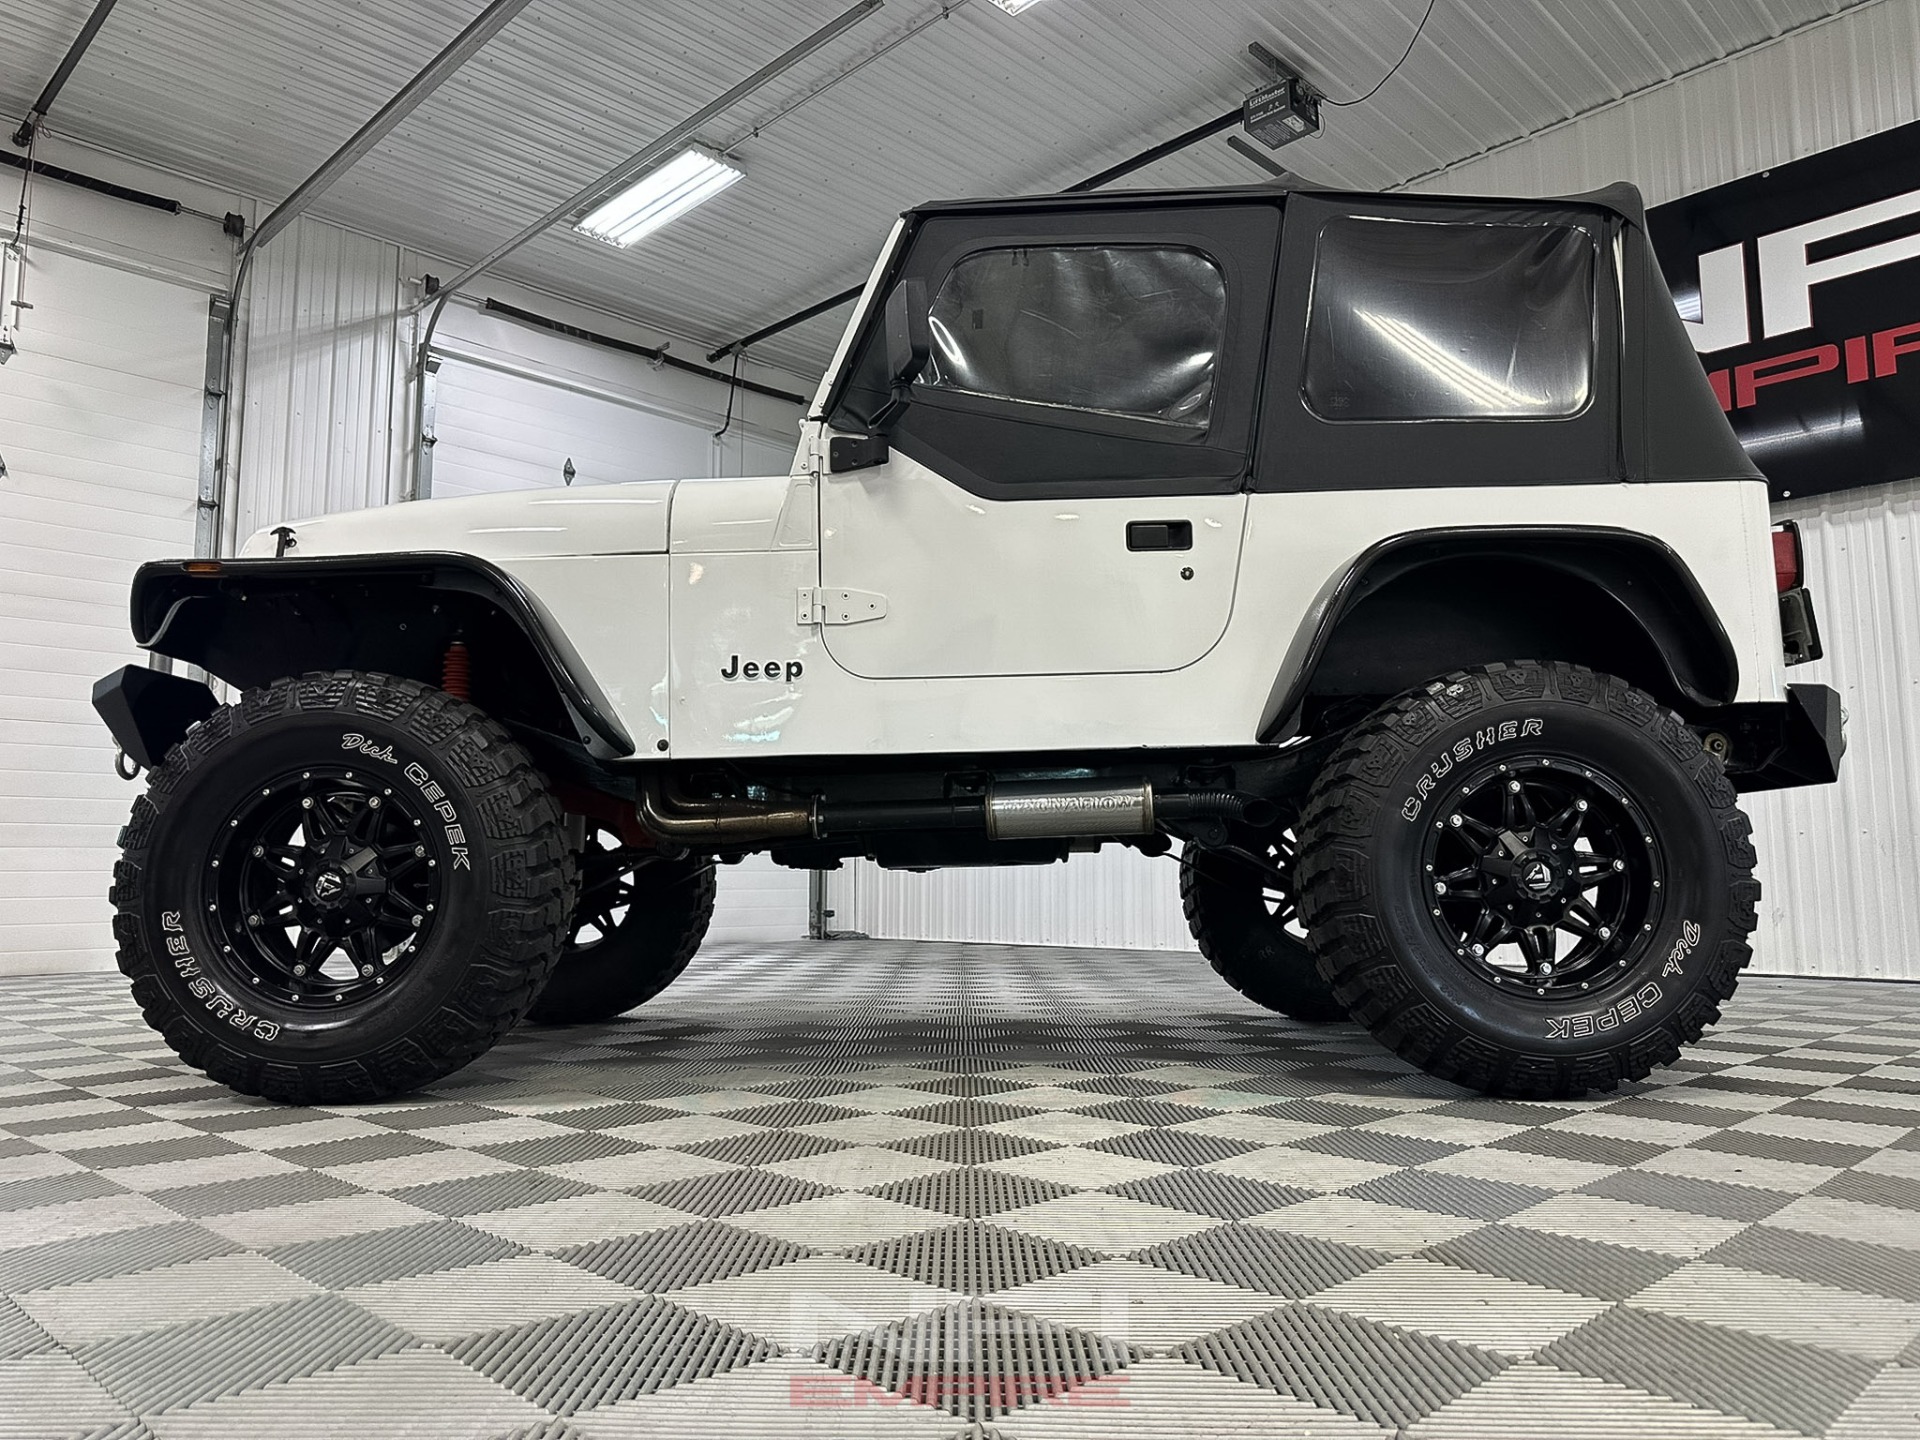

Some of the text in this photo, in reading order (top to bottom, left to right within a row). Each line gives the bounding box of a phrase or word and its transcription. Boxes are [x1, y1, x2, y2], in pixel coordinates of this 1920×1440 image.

[1706, 322, 1920, 412] PI
[721, 655, 803, 682] Jeep
[341, 732, 472, 871] Dick CEPEK
[1401, 718, 1543, 822] CRUSHER
[161, 910, 281, 1042] CRUSHER
[1545, 919, 1700, 1040] Dick CEPEK
